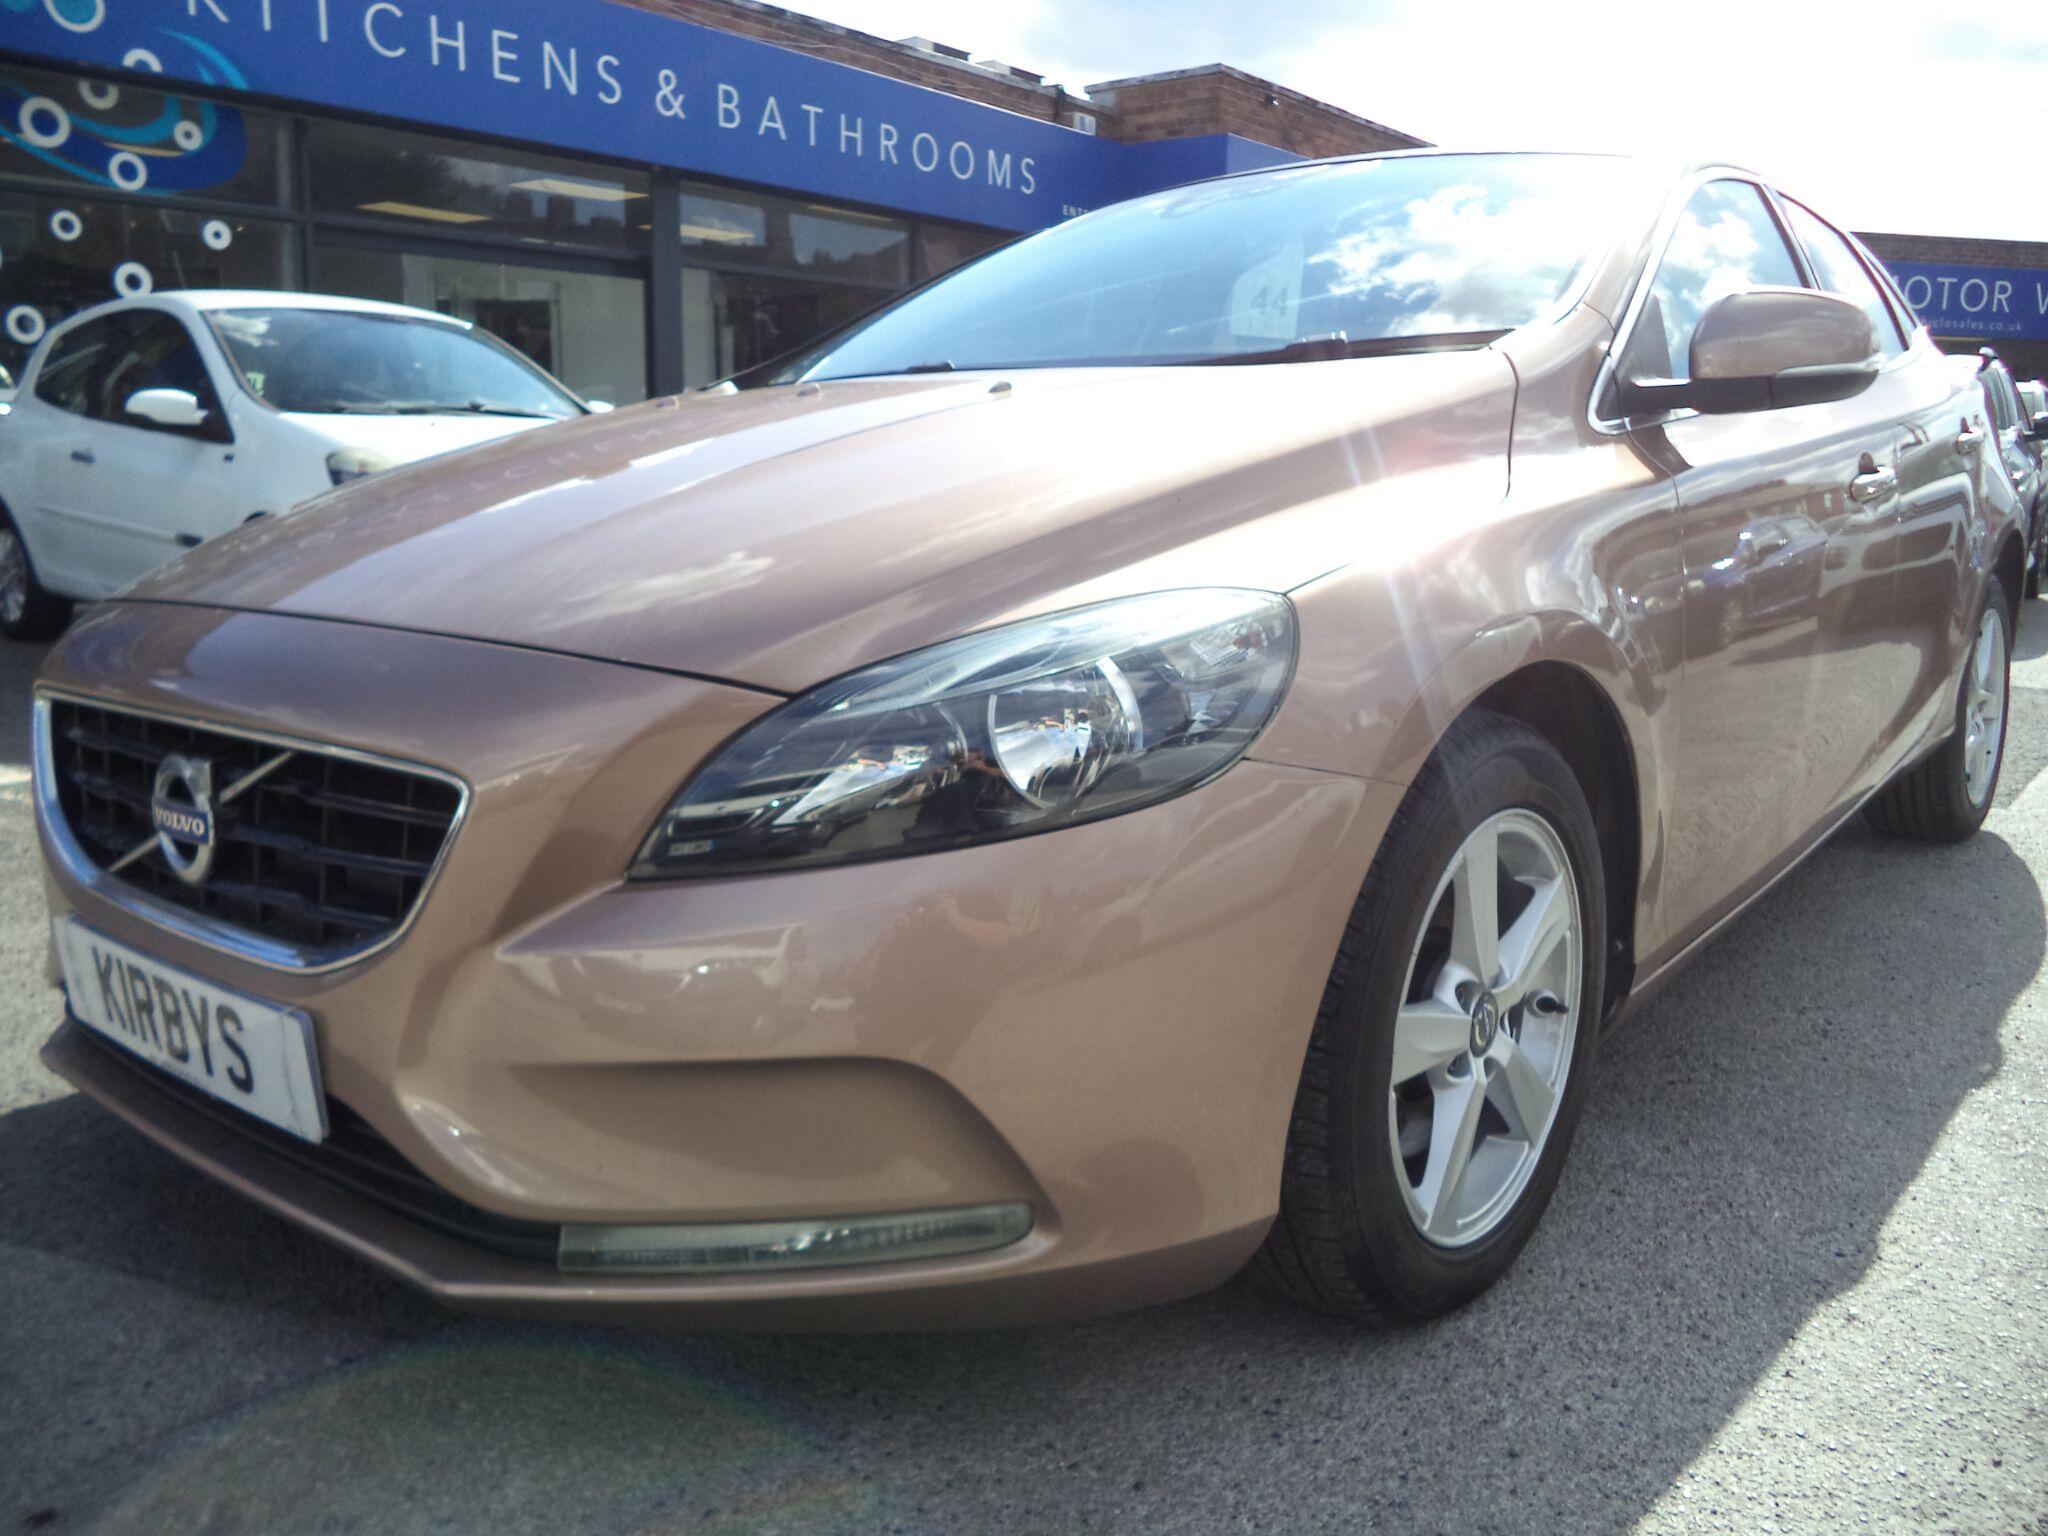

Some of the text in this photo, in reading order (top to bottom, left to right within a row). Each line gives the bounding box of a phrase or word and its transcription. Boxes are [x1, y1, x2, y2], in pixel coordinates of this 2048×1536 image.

[655, 68, 686, 119] &
[717, 83, 1036, 194] BATHROOMS
[1250, 286, 1288, 316] 44
[1894, 275, 2012, 313] OTOR
[155, 807, 205, 836] VOLVO
[92, 945, 254, 1093] KIRBYS
